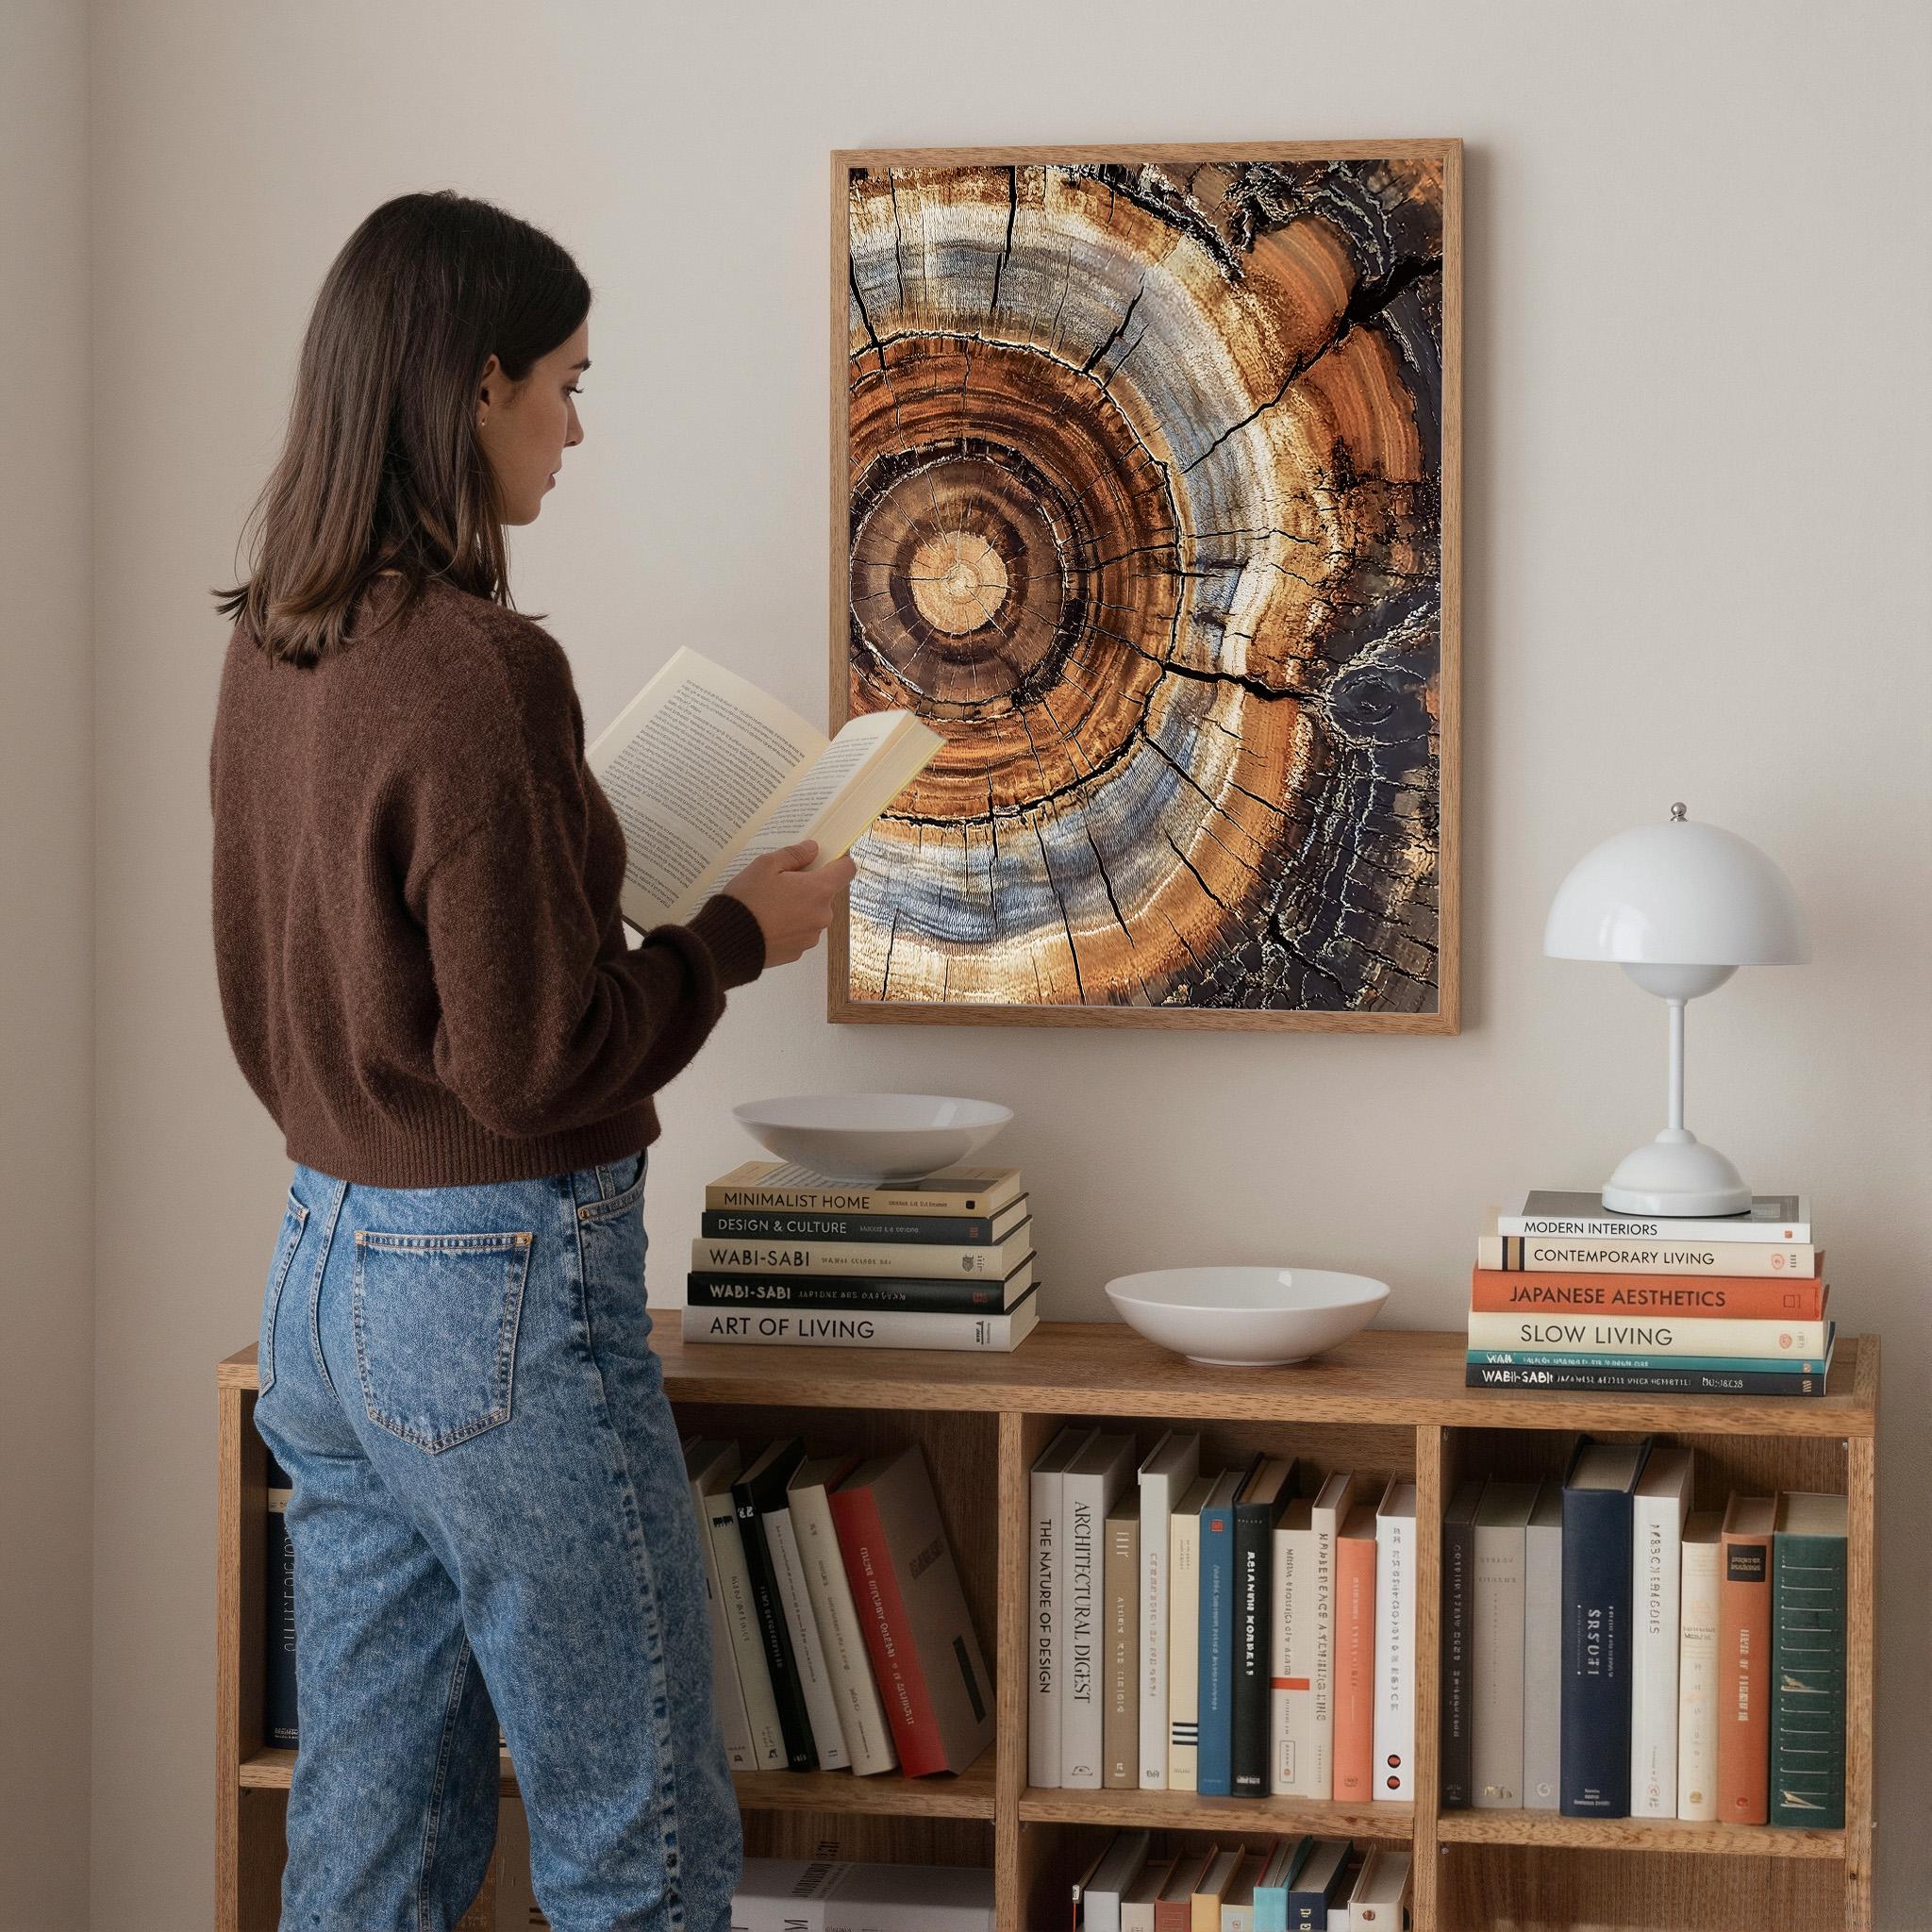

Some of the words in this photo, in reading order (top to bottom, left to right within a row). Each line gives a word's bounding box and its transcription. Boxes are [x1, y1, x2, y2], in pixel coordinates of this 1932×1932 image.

[724, 1191, 818, 1208] MINIMALIST
[823, 1196, 871, 1209] HOME
[718, 1218, 770, 1232] DESIGN
[774, 1220, 783, 1232] &
[786, 1221, 847, 1234] CULTURE
[1524, 1222, 1585, 1234] MODERN
[1588, 1223, 1658, 1236] INTERIORS
[709, 1249, 810, 1267] WABI-SABI
[1534, 1249, 1659, 1265] CONTEMPORARY
[1663, 1252, 1715, 1265] LIVING
[709, 1284, 791, 1300] WABI-SABI
[1509, 1286, 1606, 1305] JAPANESE
[1611, 1289, 1726, 1307] AESTHETICS
[709, 1317, 751, 1335] ART
[758, 1318, 790, 1336] OF
[798, 1319, 874, 1339] LIVING
[1521, 1324, 1587, 1343] SLOW
[1595, 1326, 1674, 1346] LIVING
[1039, 1518, 1052, 1547] THE
[1039, 1551, 1052, 1608] NATURE
[1074, 1501, 1091, 1641] ARCHITECTURAL
[1039, 1612, 1052, 1634] OF
[1039, 1638, 1051, 1693] DESIGN
[1074, 1644, 1091, 1704] DIGEST
